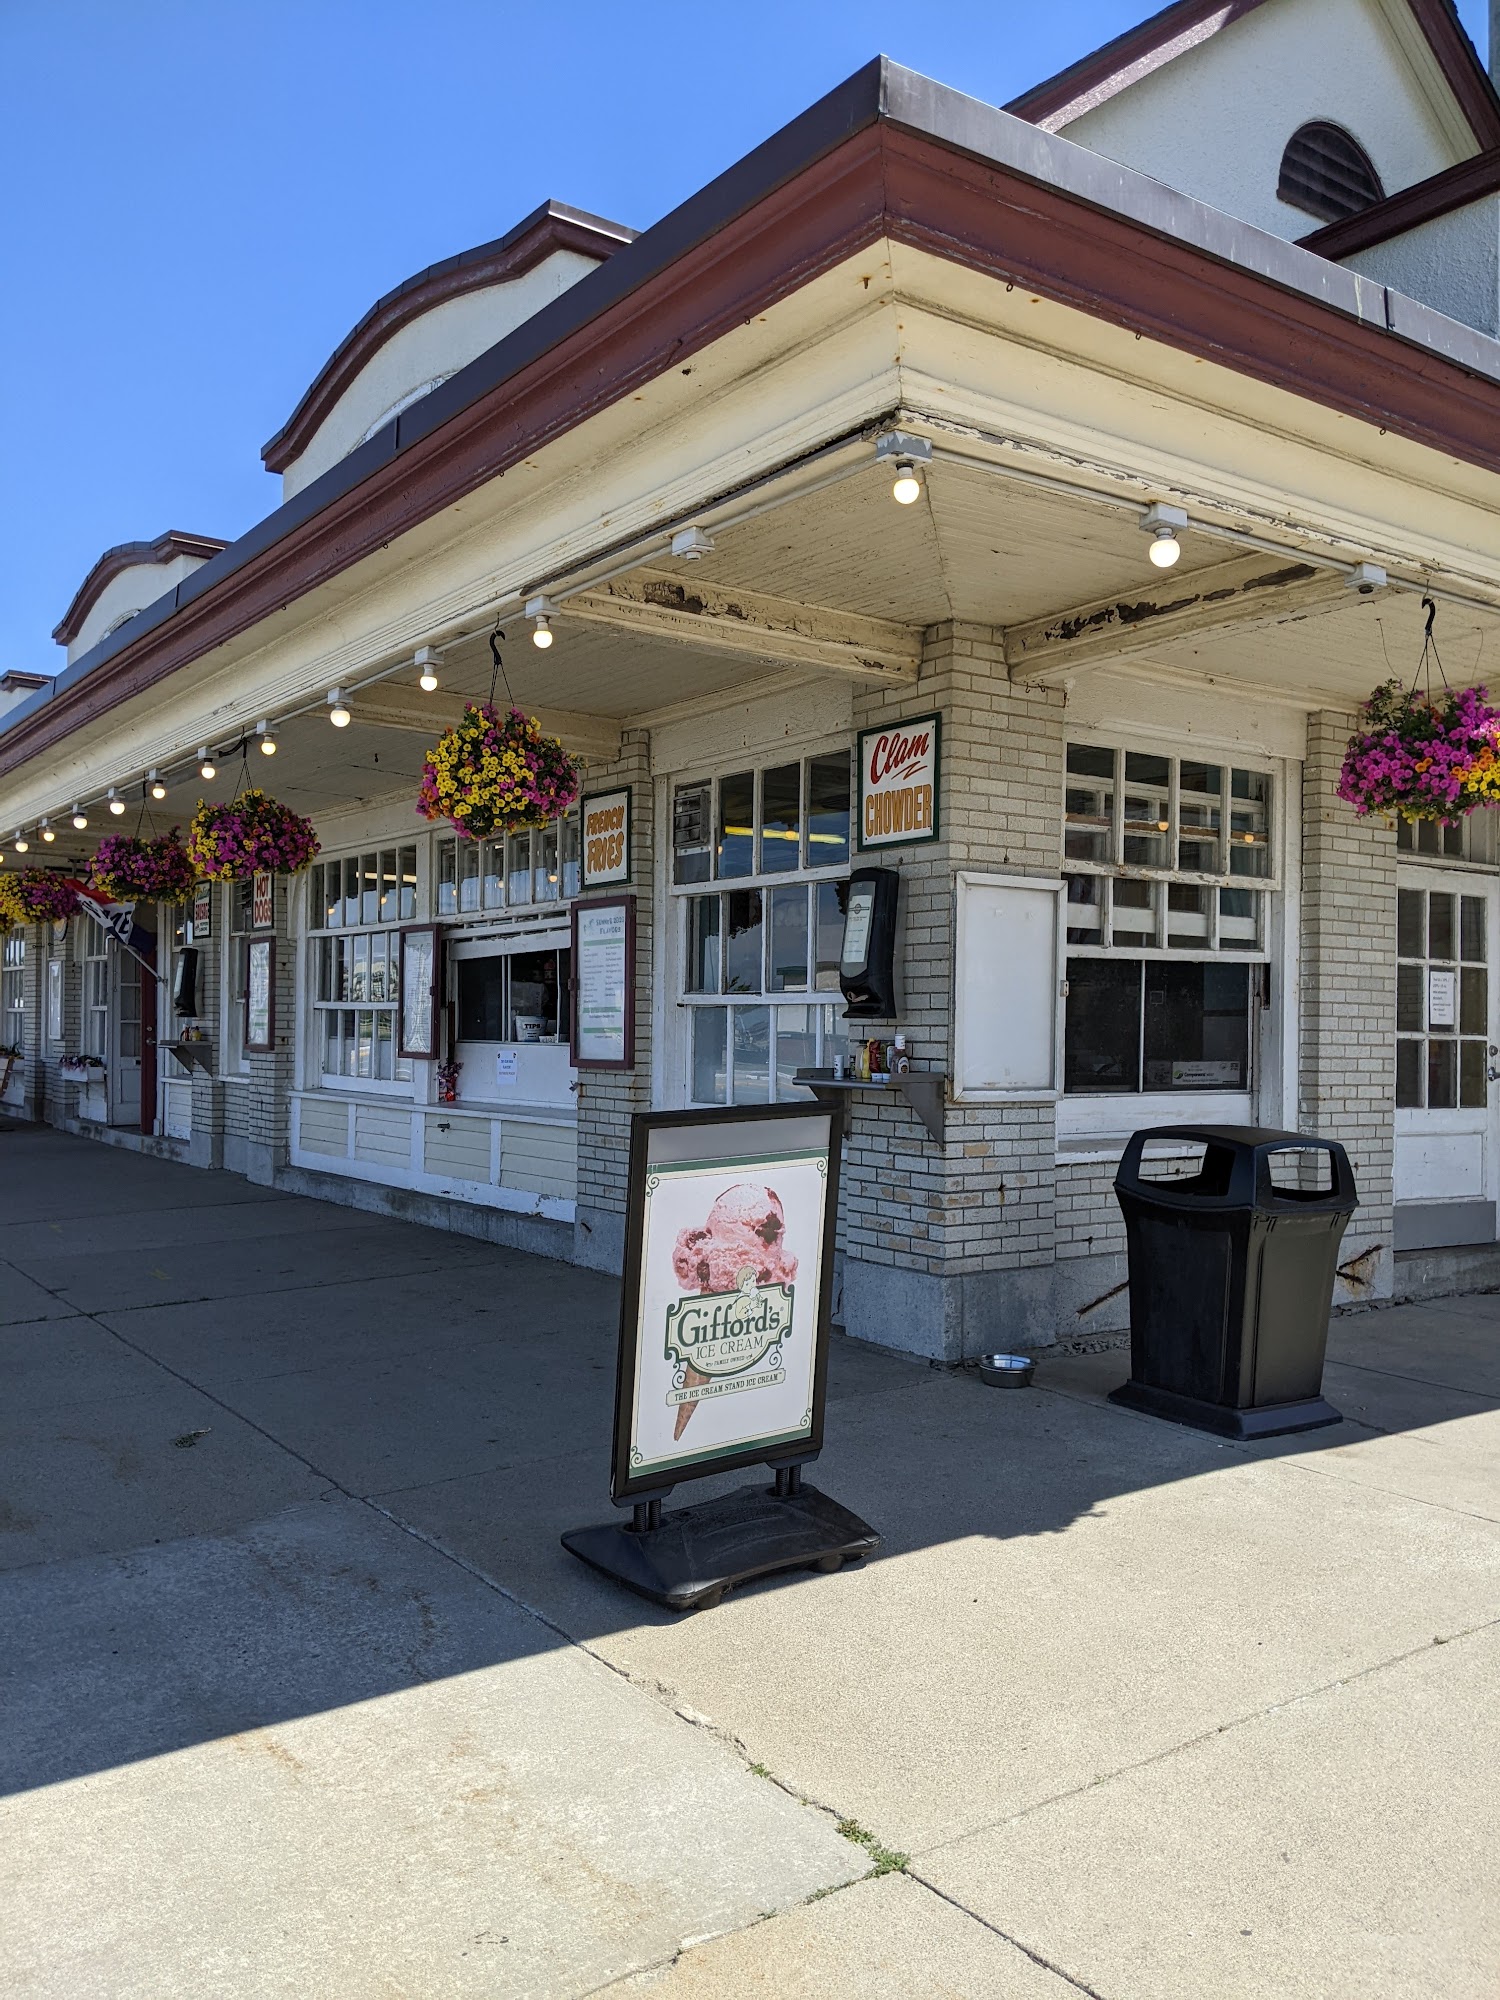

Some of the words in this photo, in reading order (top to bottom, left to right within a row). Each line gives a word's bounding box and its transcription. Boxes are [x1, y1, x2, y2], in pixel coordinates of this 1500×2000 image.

[870, 732, 930, 785] Clam
[586, 805, 625, 837] FRENCH
[865, 783, 933, 837] CHOWDER
[587, 831, 625, 874] FRIES
[256, 875, 270, 898] HOT
[254, 898, 272, 924] DOGS
[677, 1297, 780, 1347] Gifford's
[696, 1344, 715, 1360] ICE
[720, 1335, 763, 1355] CREAM
[714, 1358, 729, 1366] FAMILY
[730, 1355, 745, 1363] OWNED
[675, 1392, 687, 1401] THE
[689, 1389, 699, 1398] ICE
[701, 1385, 723, 1396] CREAM
[724, 1380, 745, 1391] STAND
[746, 1377, 757, 1386] ICE
